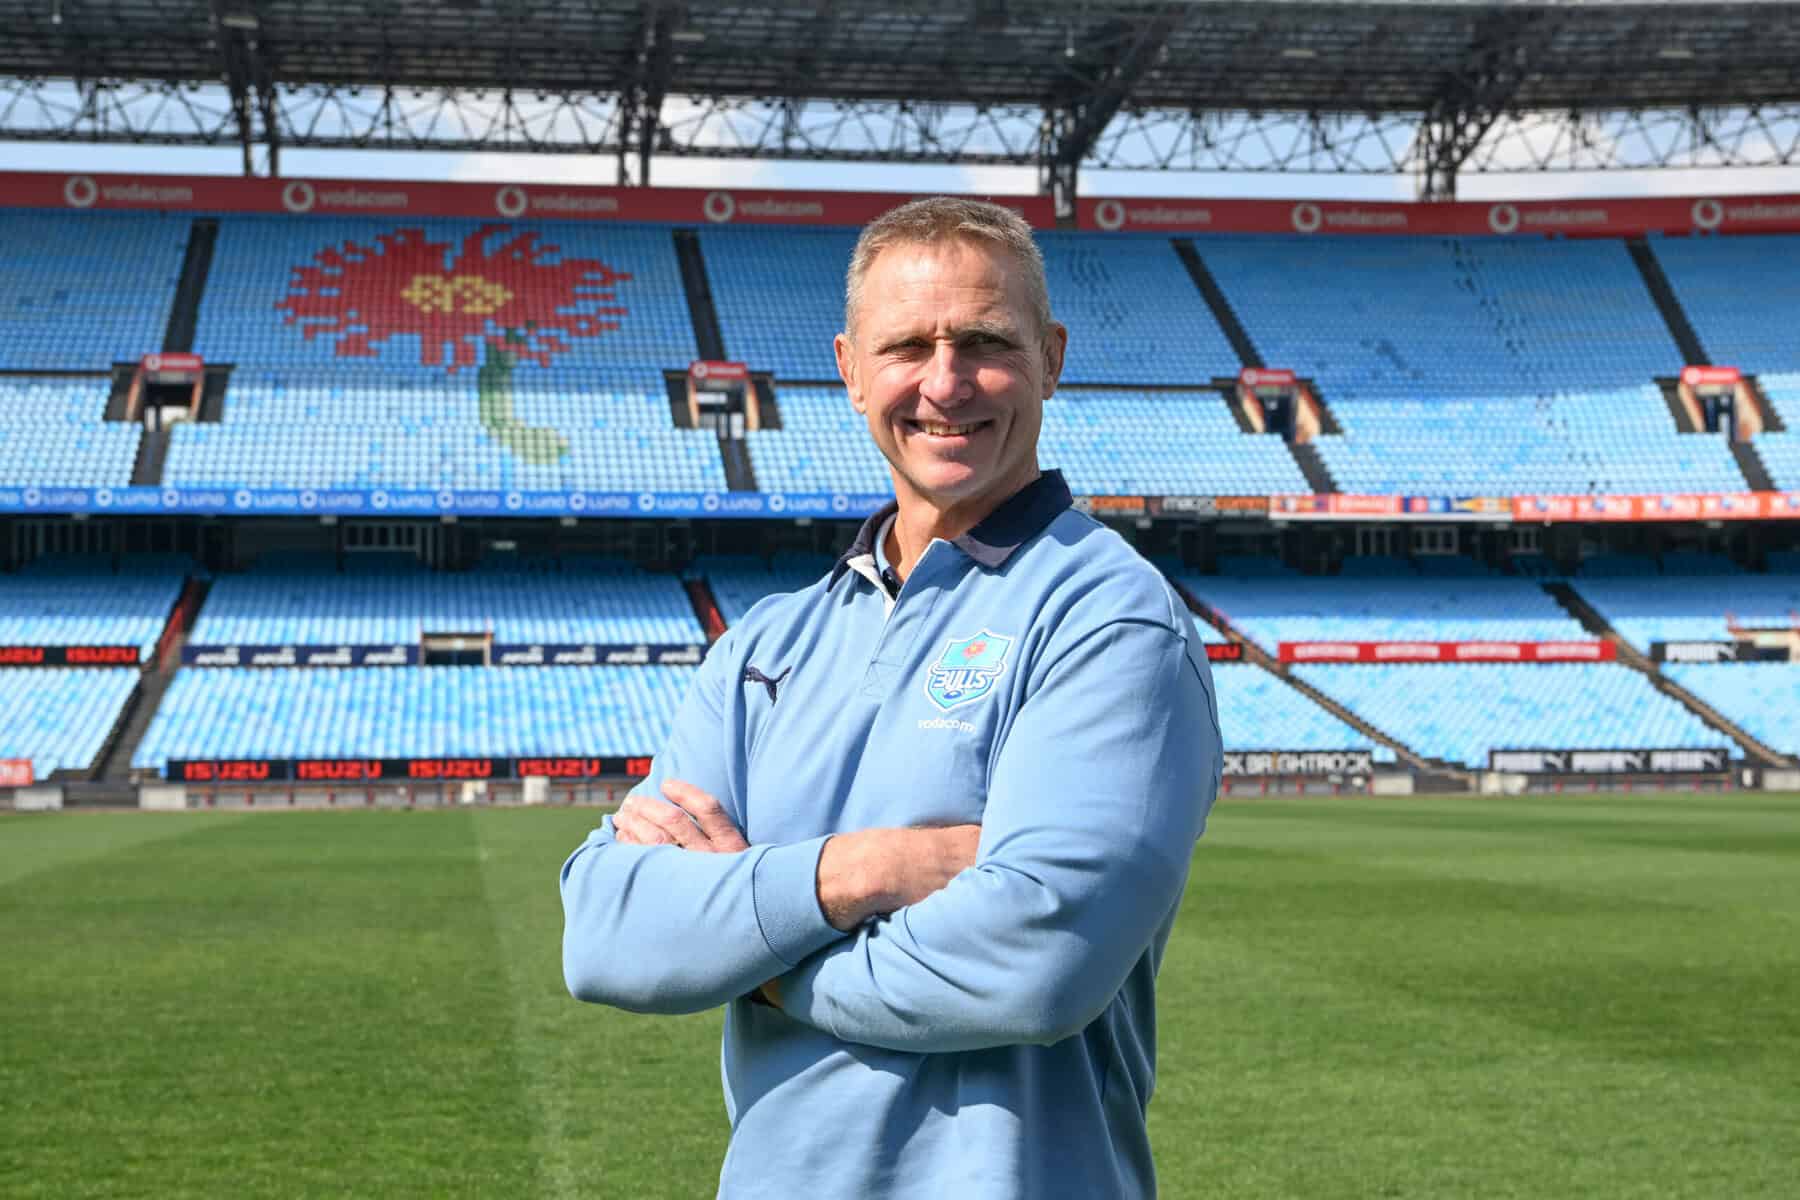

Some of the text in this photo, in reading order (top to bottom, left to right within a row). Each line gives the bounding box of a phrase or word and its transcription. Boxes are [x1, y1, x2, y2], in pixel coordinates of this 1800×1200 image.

[66, 647, 137, 663] ISUZU
[932, 670, 986, 690] BULLS
[917, 718, 977, 734] vodacom
[184, 759, 599, 779] ISUZU ISUZU ISUZU ISUZU
[1246, 752, 1373, 774] BRIGHTROCK
